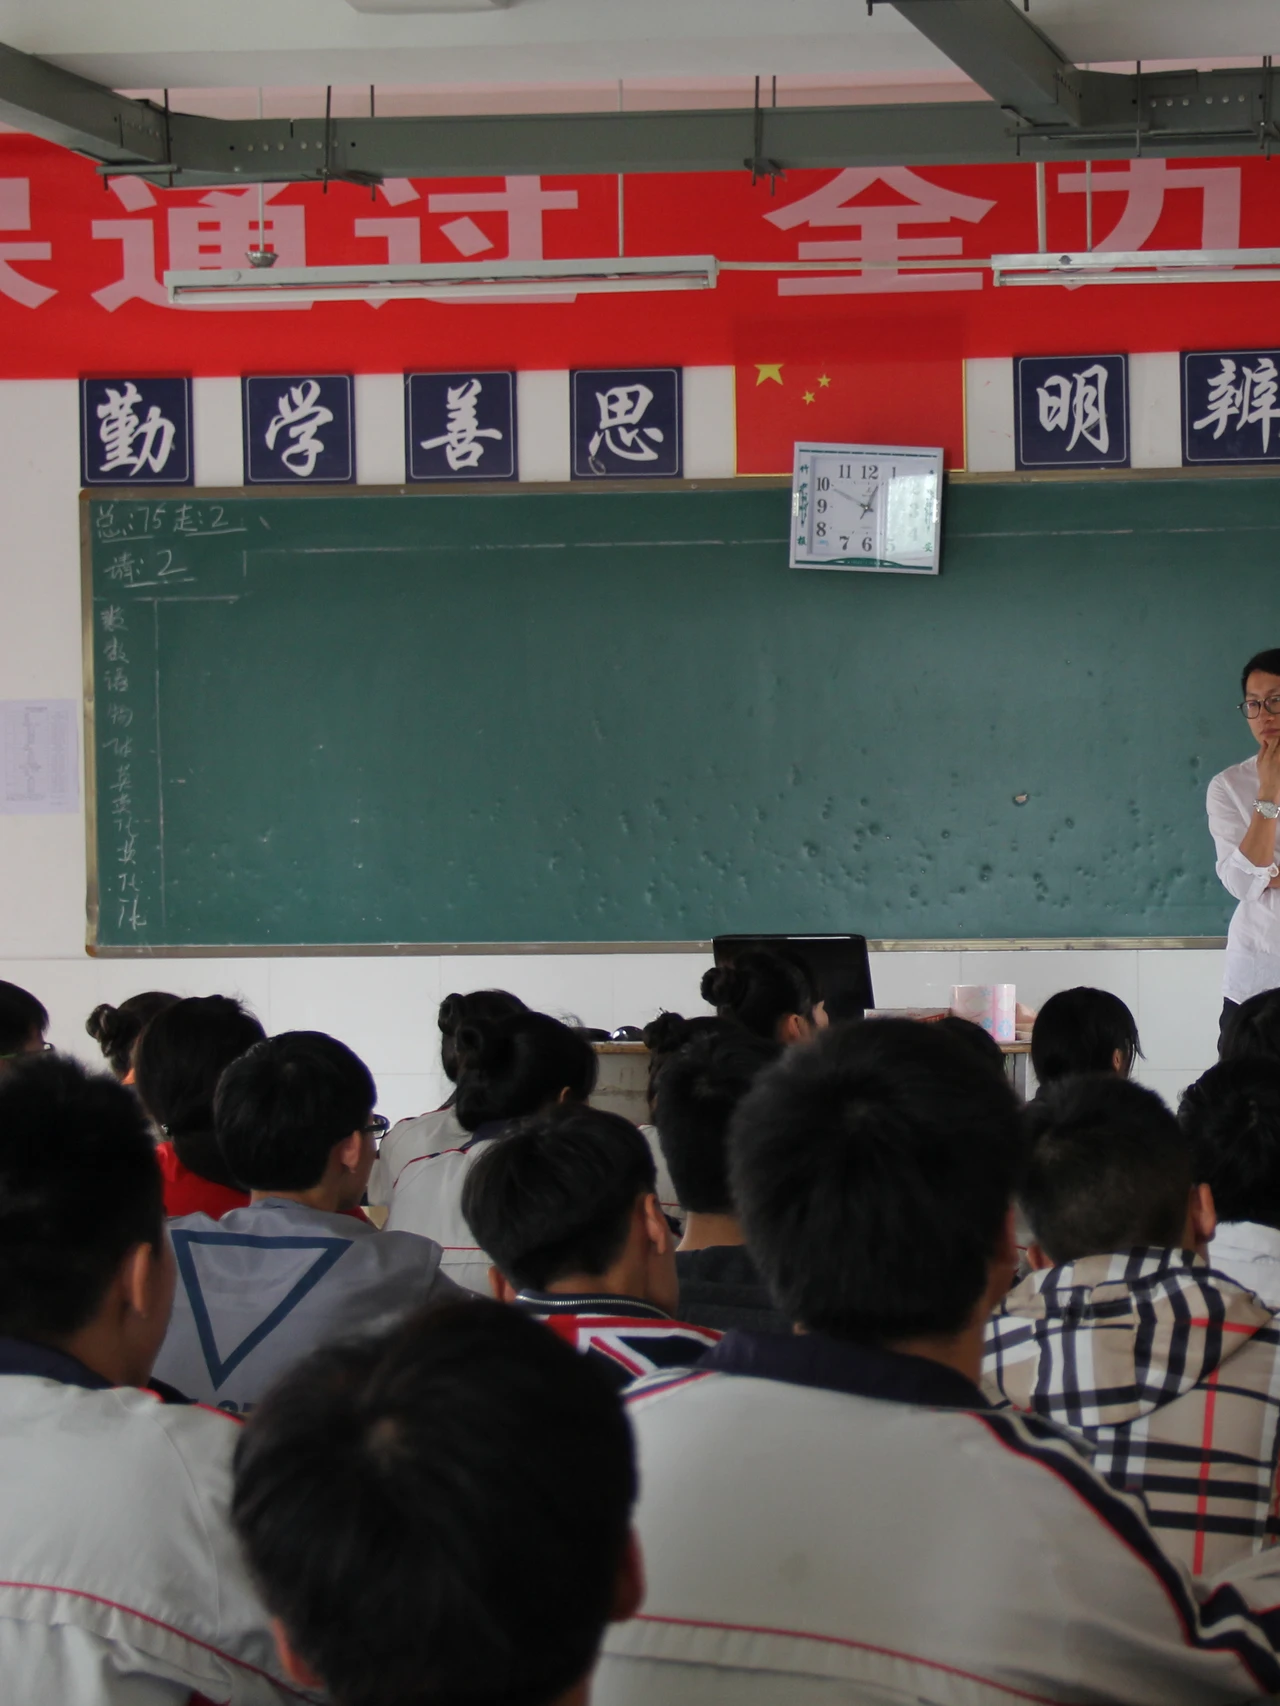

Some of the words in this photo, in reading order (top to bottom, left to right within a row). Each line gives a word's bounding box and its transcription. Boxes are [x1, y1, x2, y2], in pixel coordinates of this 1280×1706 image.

[838, 464, 851, 479] 11
[861, 465, 878, 480] 12
[816, 477, 830, 491] 10
[817, 499, 827, 513] 9
[816, 522, 826, 537] 8
[839, 536, 850, 551] 7
[862, 537, 873, 552] 6
